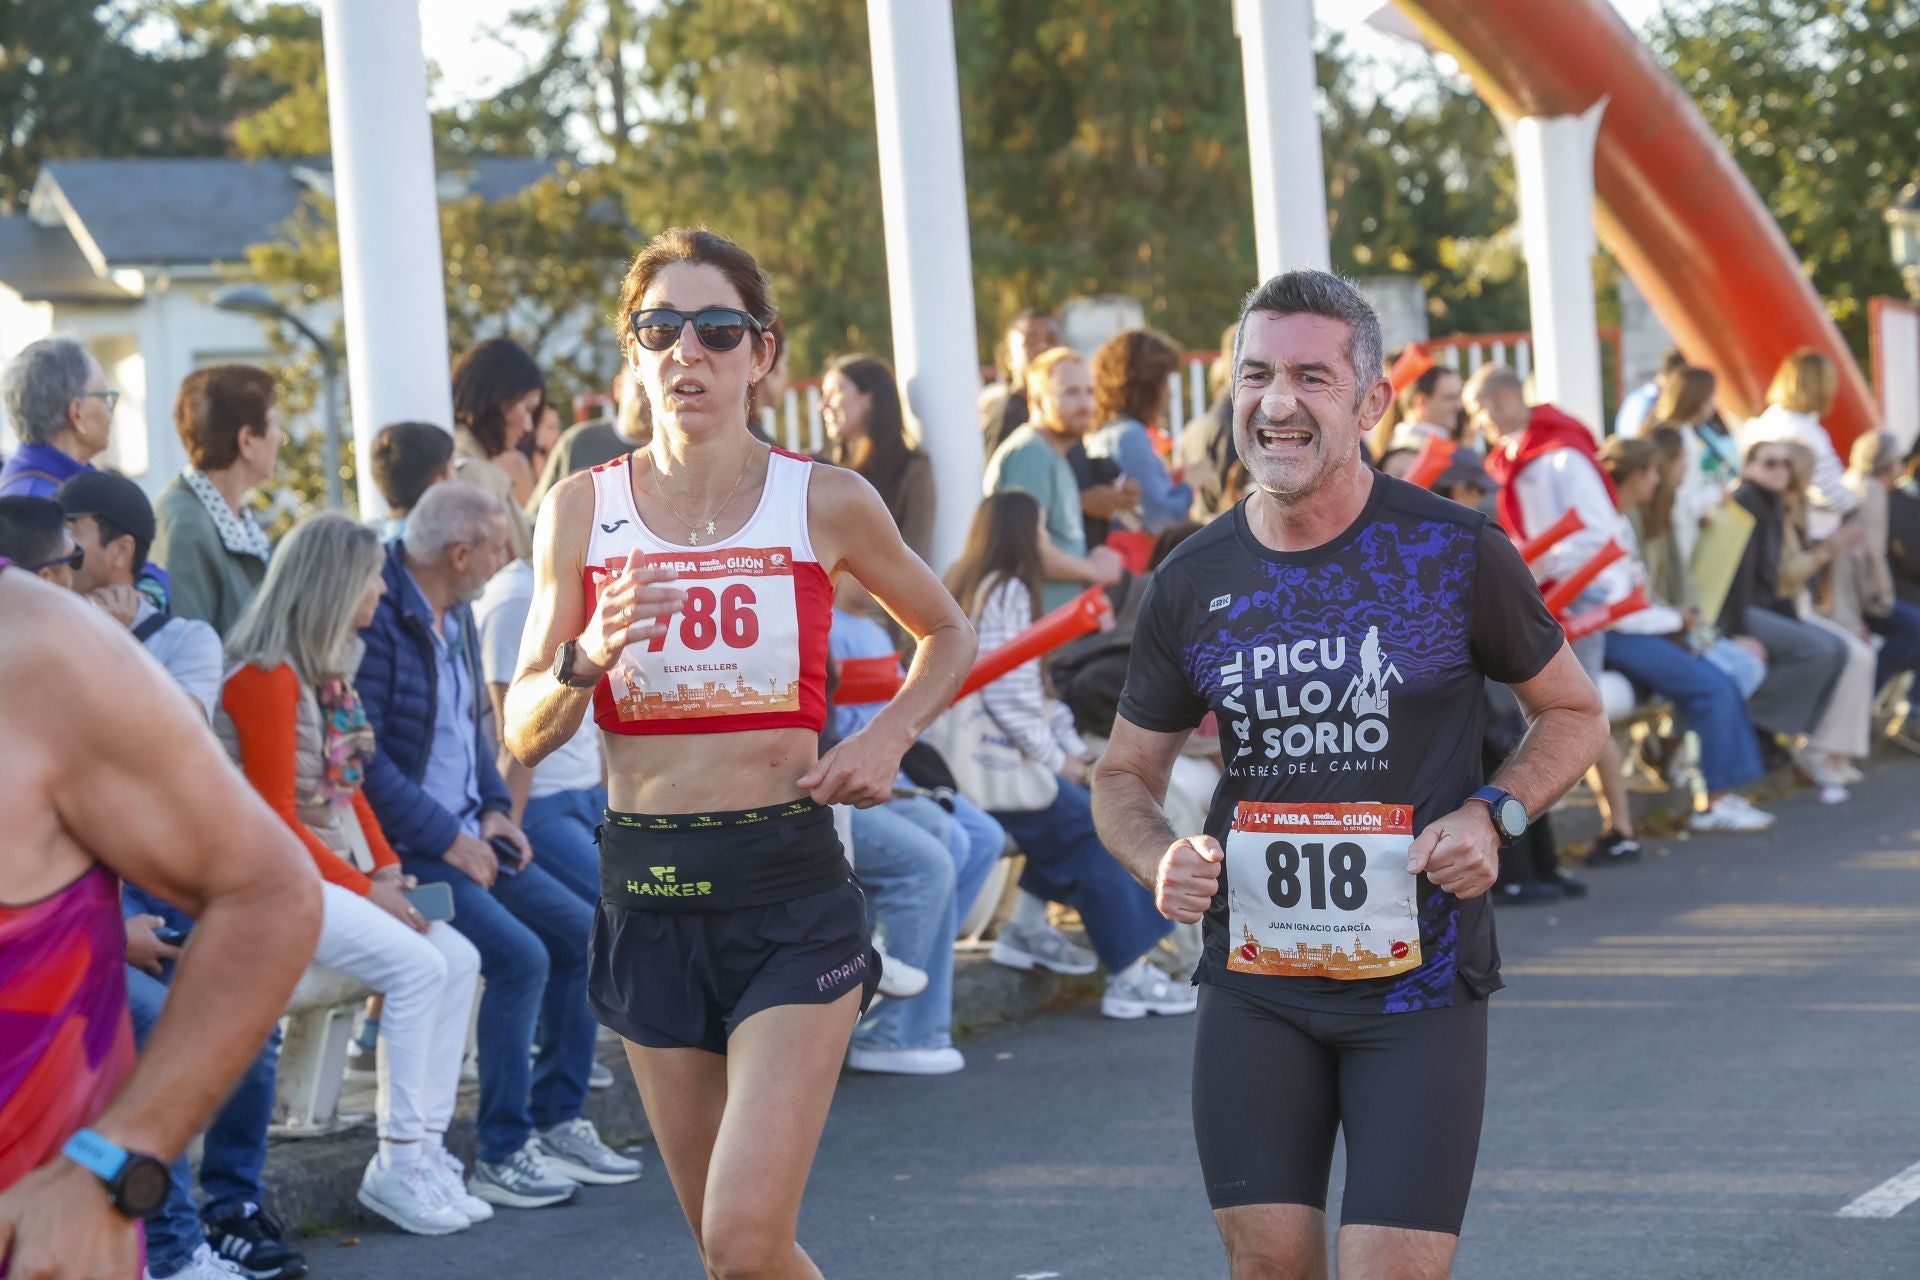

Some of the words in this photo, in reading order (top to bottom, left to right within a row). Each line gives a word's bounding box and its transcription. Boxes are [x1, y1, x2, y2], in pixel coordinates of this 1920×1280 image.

[660, 561, 697, 571] MBA
[727, 556, 763, 568] GIJÓN
[1253, 636, 1346, 680] PICU
[664, 664, 694, 673] ELENA
[696, 663, 738, 671] SELLERS
[1255, 680, 1332, 720] LLO
[1263, 718, 1389, 759] SORIO
[1230, 764, 1279, 777] MIERES
[1288, 762, 1318, 775] DEL
[1329, 757, 1389, 771] CAMÍN
[1273, 813, 1311, 825] MBA
[1313, 812, 1335, 820] media
[1313, 818, 1342, 826] maratón
[1342, 811, 1382, 826] GIJÓN
[1265, 840, 1368, 911] 818
[627, 880, 711, 896] HANKER
[1268, 922, 1292, 930] JUAN
[1294, 923, 1331, 932] IGNACIO
[1333, 923, 1371, 932] GARCÍA
[816, 953, 866, 992] KIPRUN
